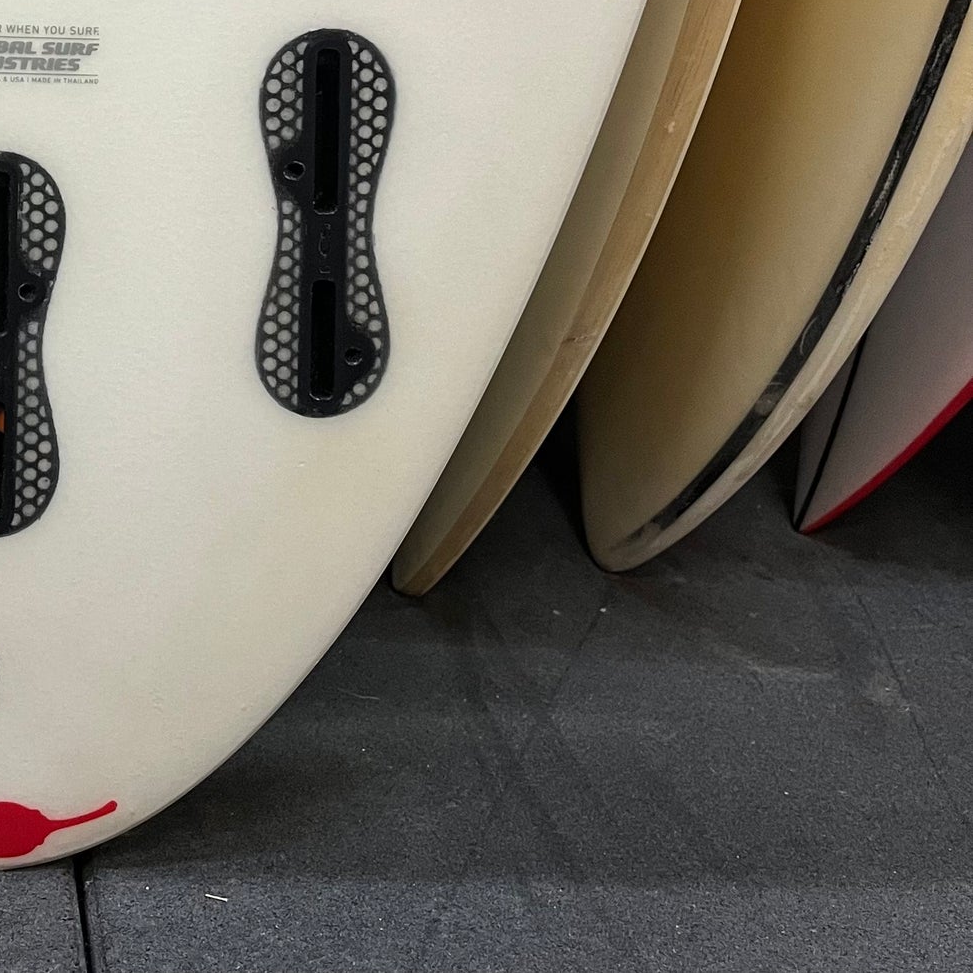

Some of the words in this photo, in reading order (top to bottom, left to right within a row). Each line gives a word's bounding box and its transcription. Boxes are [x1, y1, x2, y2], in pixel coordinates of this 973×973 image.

[6, 24, 40, 35] WHEN
[43, 25, 66, 36] YOU
[41, 41, 100, 56] SURF
